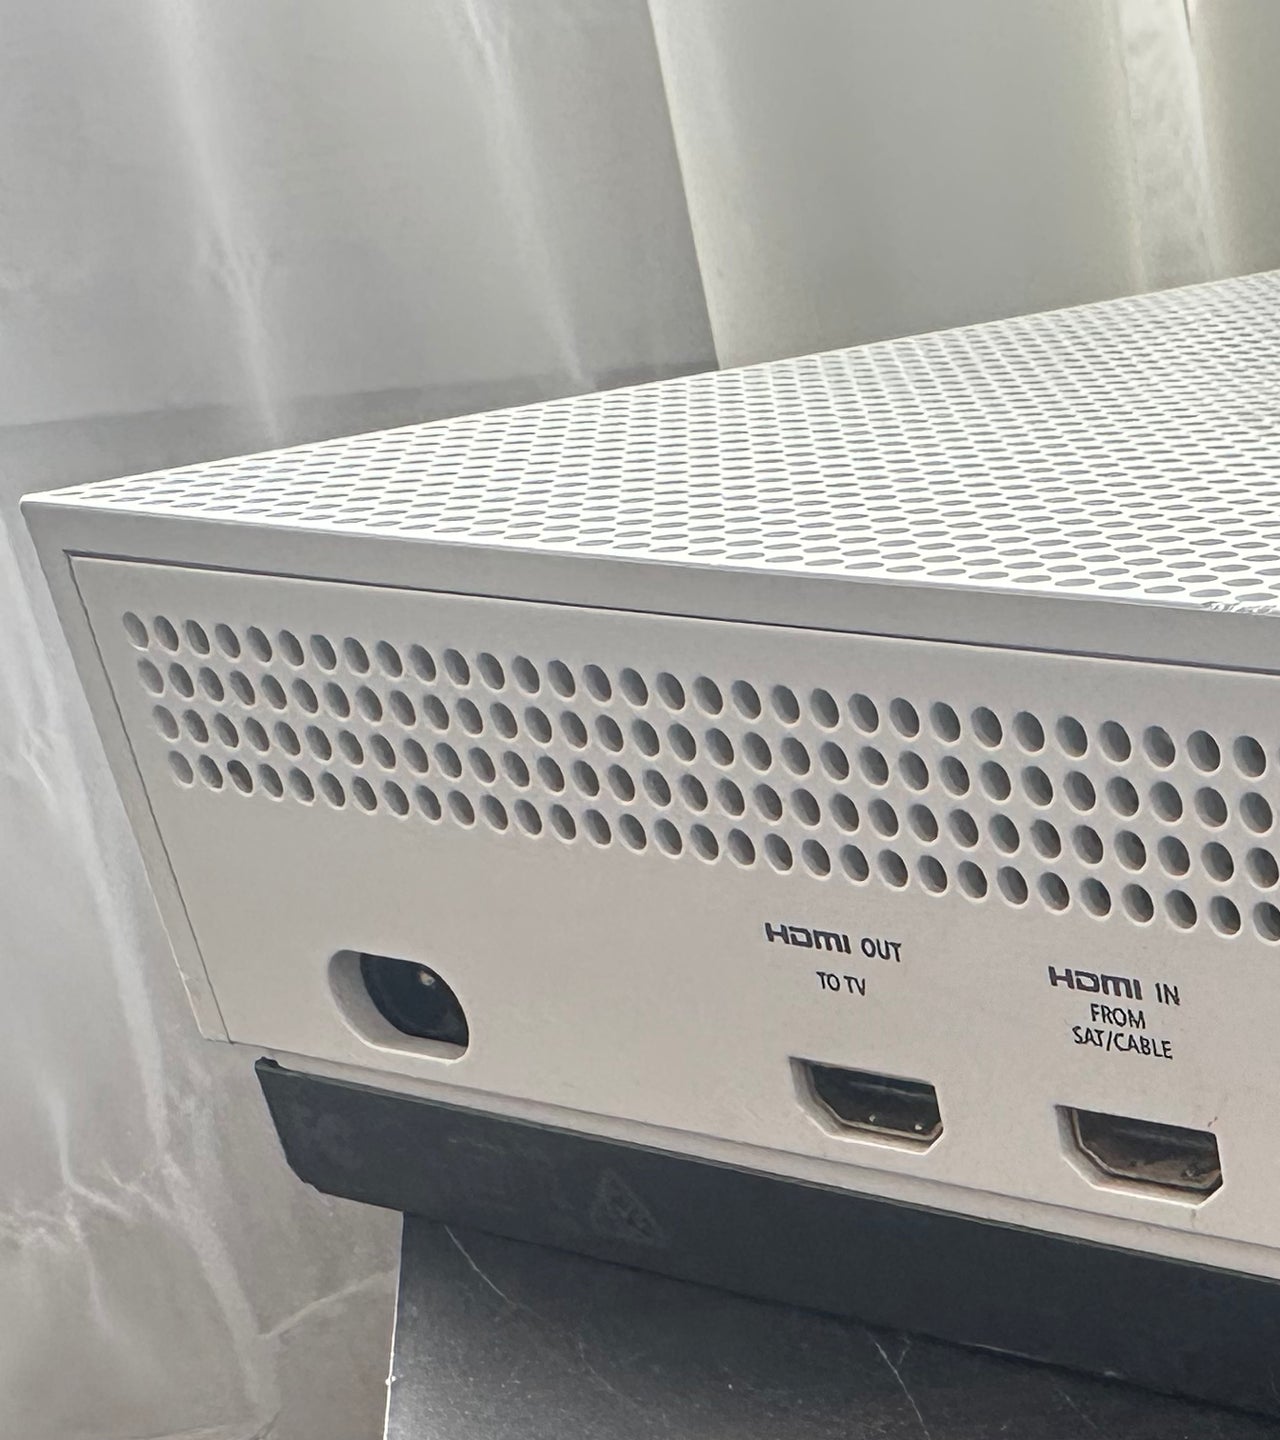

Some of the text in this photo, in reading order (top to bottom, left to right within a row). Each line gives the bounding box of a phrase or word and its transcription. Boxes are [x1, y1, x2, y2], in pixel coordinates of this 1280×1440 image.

[764, 923, 902, 962] HDMI OUT
[816, 971, 866, 996] TO TV
[1048, 966, 1181, 1006] HDMI IN
[1090, 1004, 1146, 1030] FROM
[1072, 1026, 1173, 1060] SAT/CABLE
